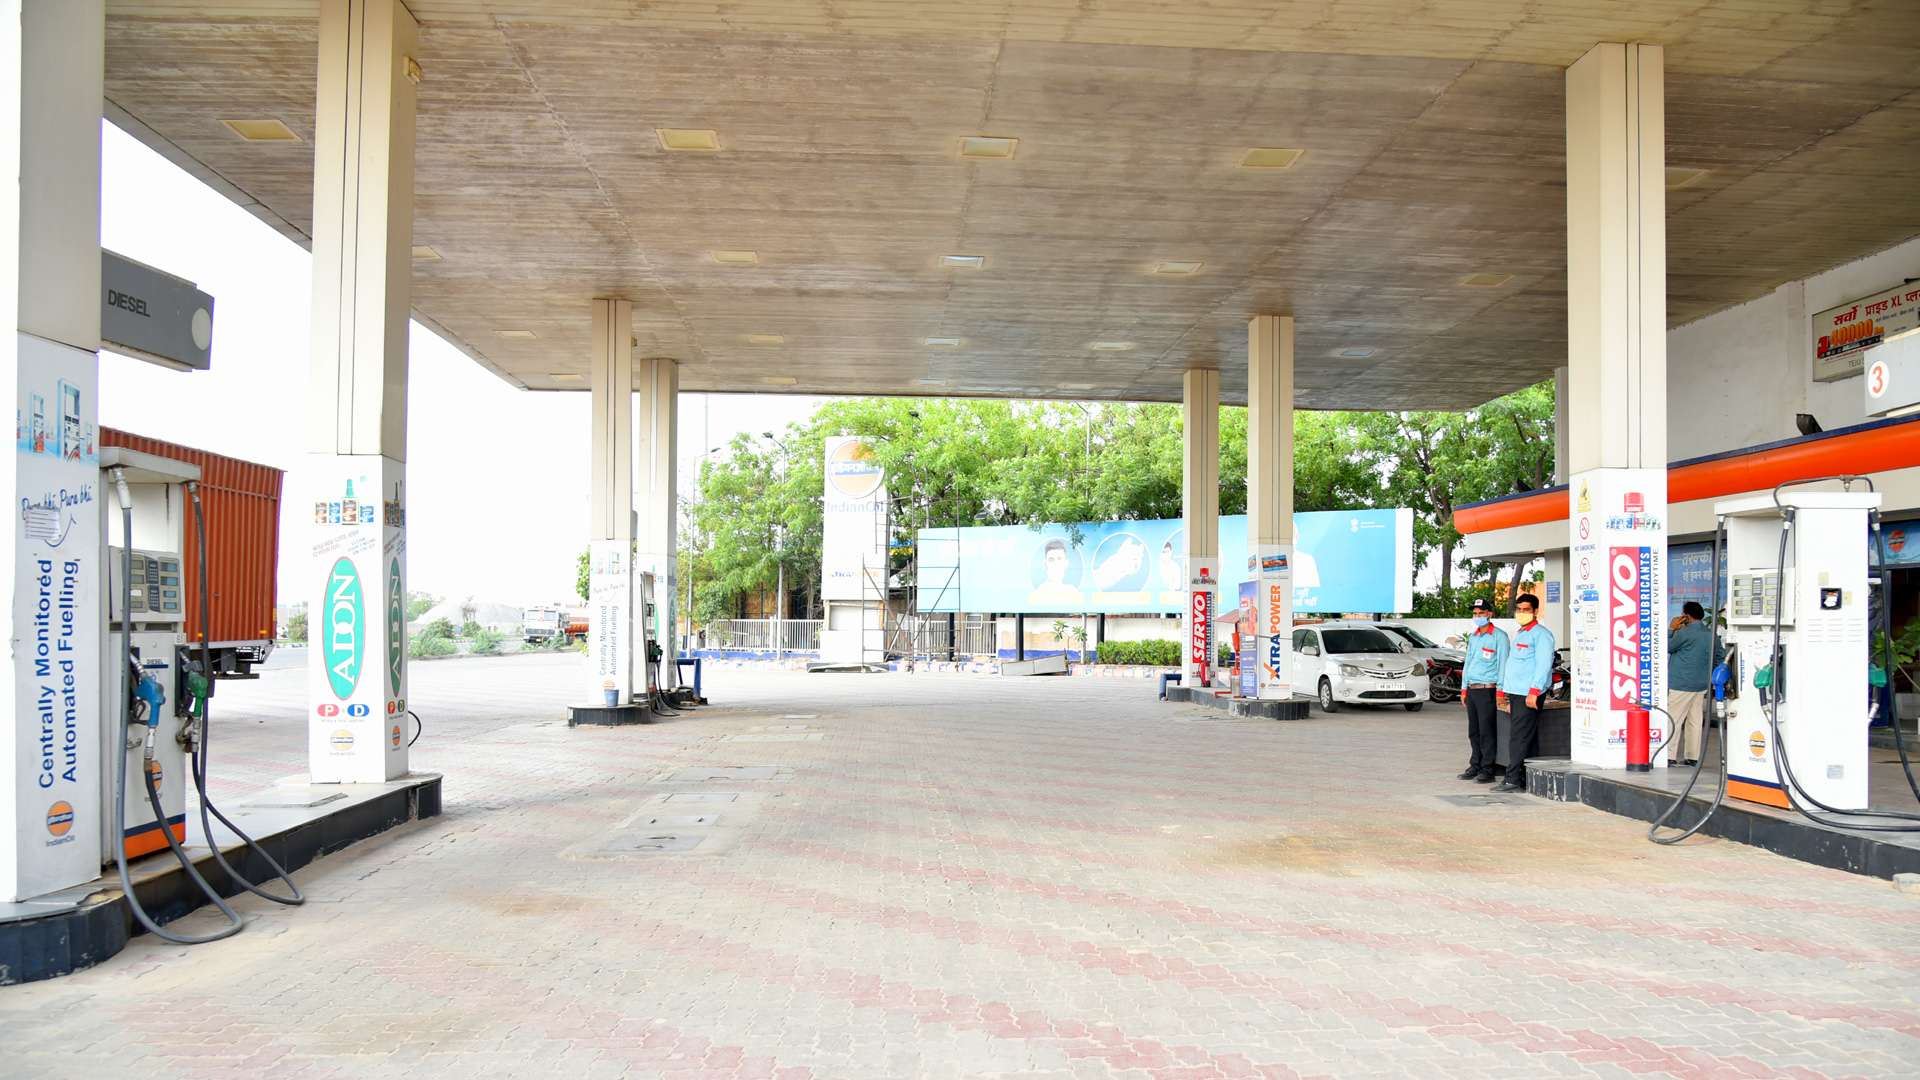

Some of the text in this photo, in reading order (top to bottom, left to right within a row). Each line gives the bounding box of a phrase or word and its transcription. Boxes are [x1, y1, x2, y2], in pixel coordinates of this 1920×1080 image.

[108, 289, 150, 318] DIESEL
[1890, 295, 1903, 308] XL
[1830, 318, 1874, 347] 40000
[1872, 365, 1883, 393] 3
[827, 501, 884, 513] IndianOil
[1682, 545, 1714, 566] तरक्की
[33, 559, 53, 677] Monitored
[332, 571, 356, 686] ADON
[1193, 594, 1205, 661] SERVO
[1264, 584, 1281, 680] XTRAPOWER
[1612, 553, 1638, 704] SERVO
[1640, 552, 1651, 706] WORLD-CLASS LUBRICANTS
[176, 635, 183, 643] B1
[57, 561, 79, 783] Automated Fuelling
[325, 705, 334, 716] P
[354, 705, 365, 716] D
[37, 684, 56, 789] Centrally
[46, 835, 75, 847] IndianOil
